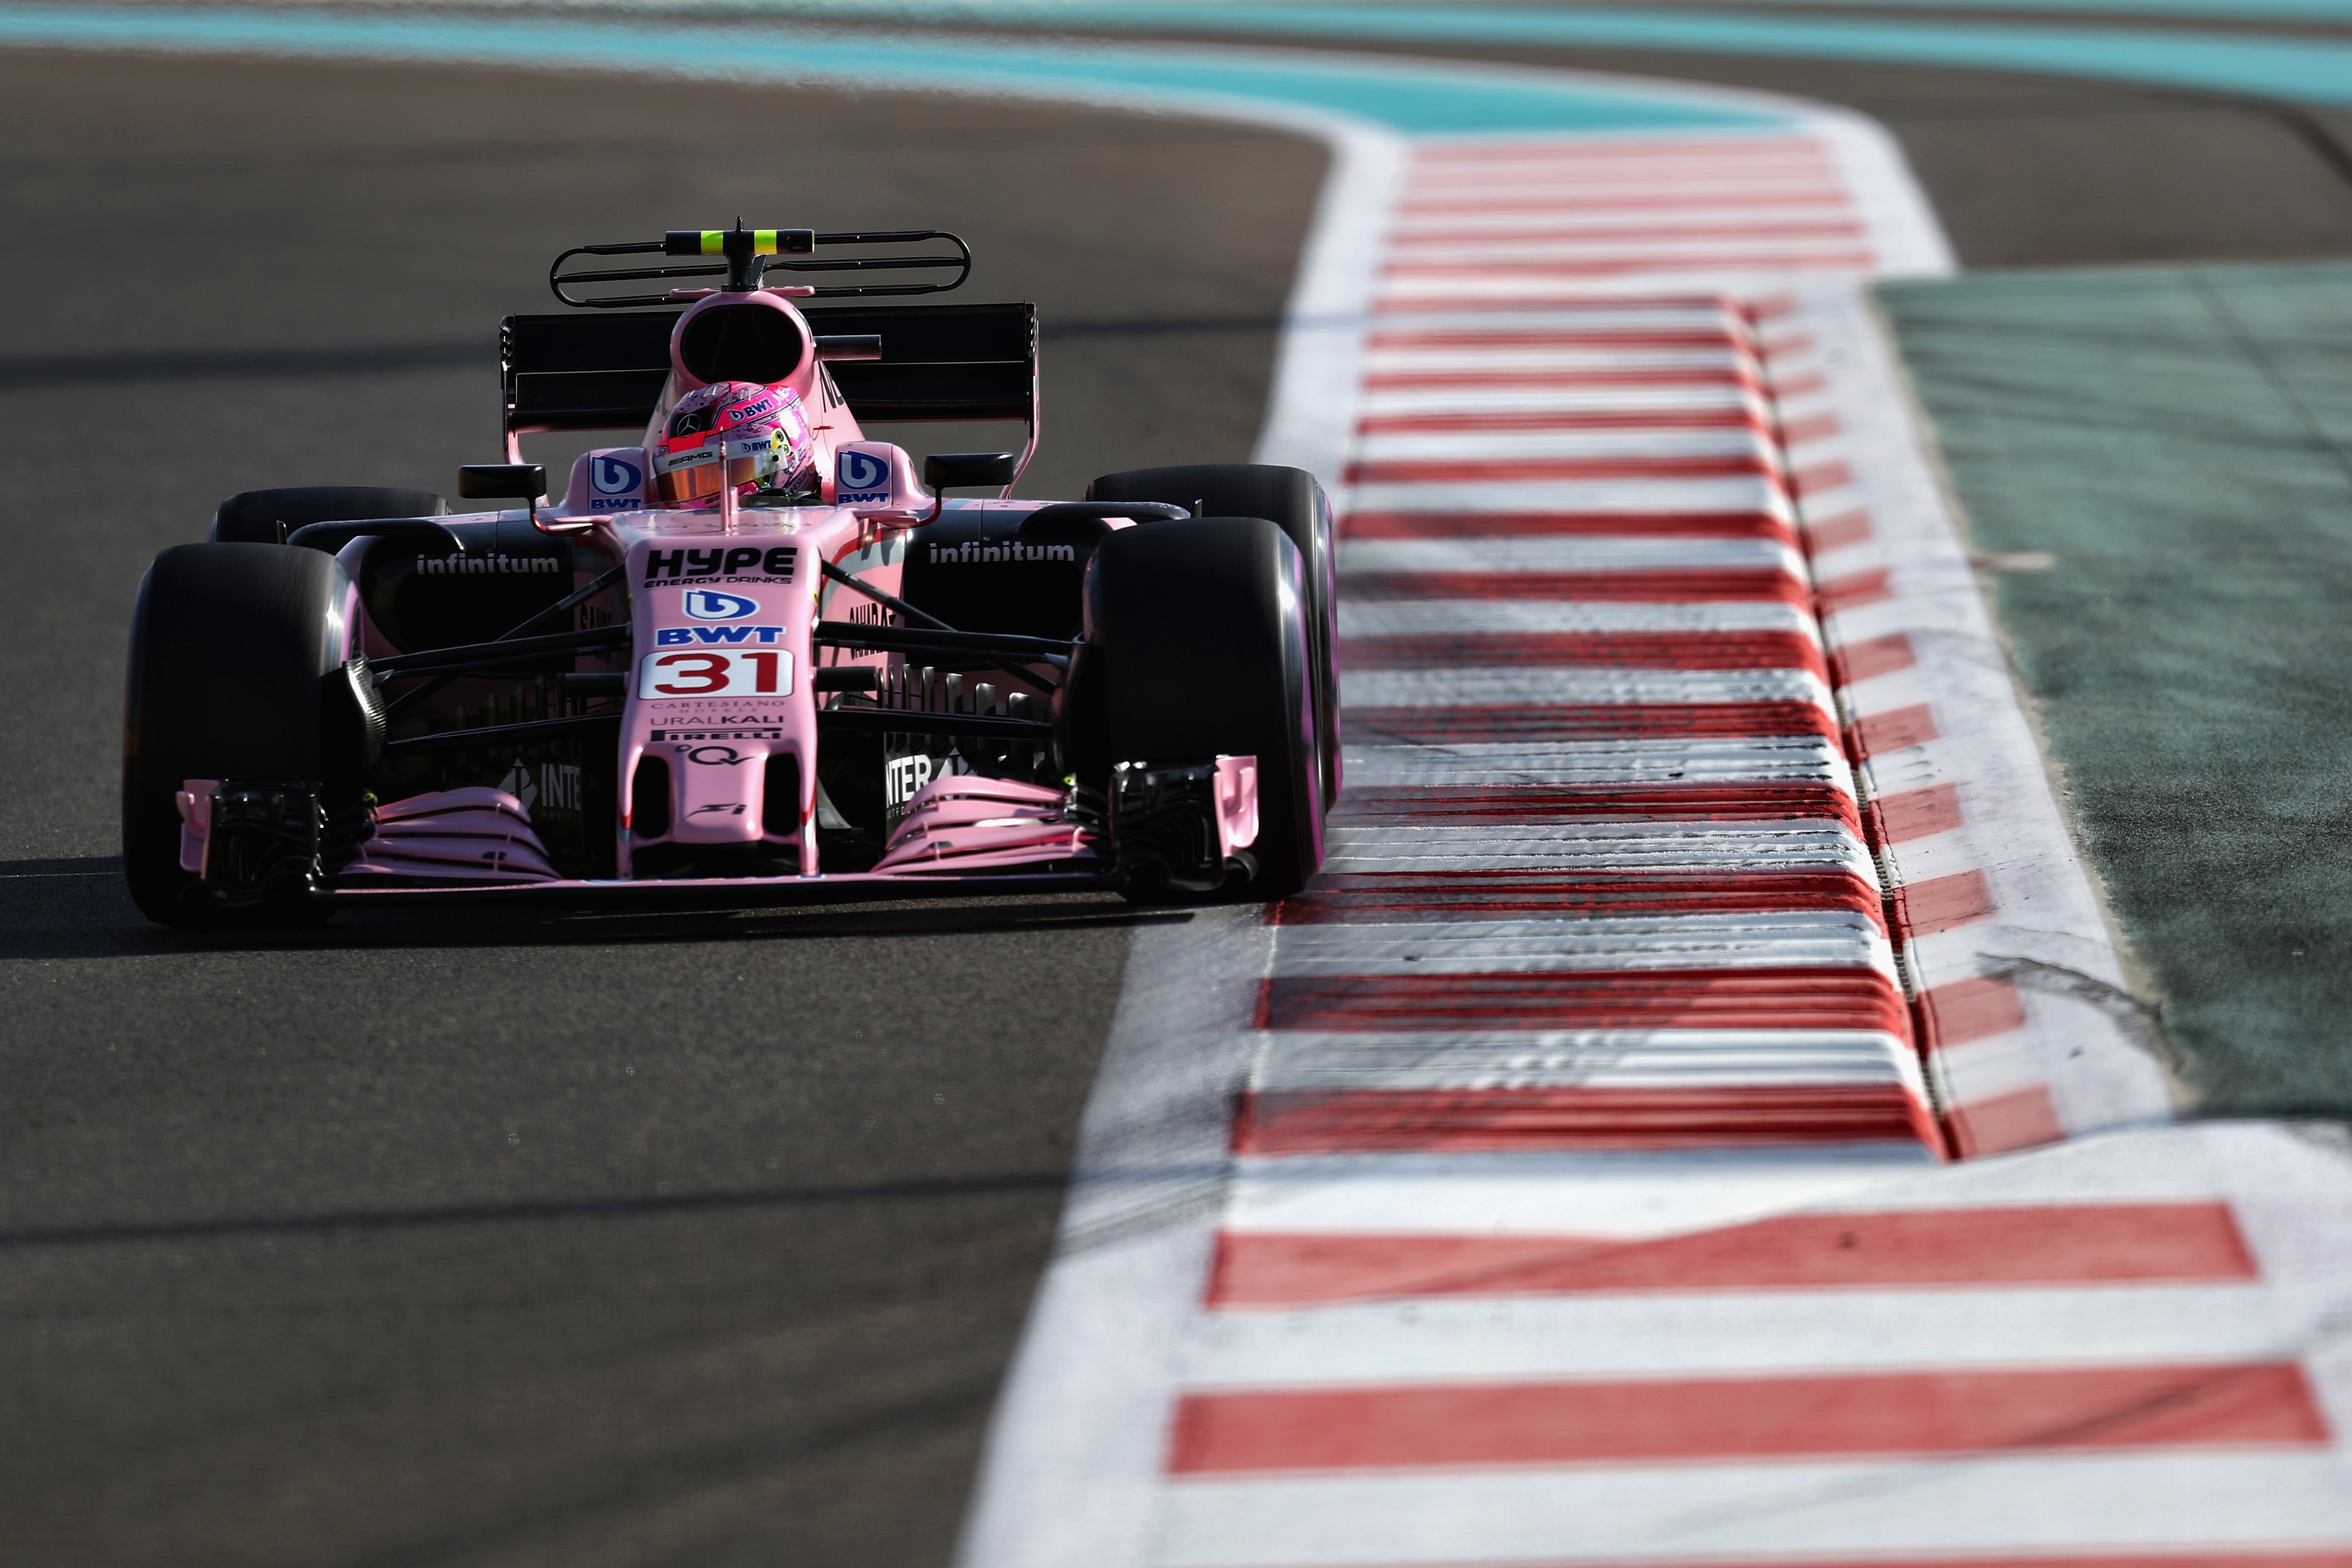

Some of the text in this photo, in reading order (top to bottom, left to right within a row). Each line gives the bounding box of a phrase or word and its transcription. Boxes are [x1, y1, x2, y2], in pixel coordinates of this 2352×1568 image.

[742, 399, 773, 418] BWT
[752, 440, 772, 451] BWT
[680, 451, 713, 462] AMG
[591, 498, 641, 509] BWT
[838, 492, 889, 504] BWT
[929, 540, 1075, 564] infinitum
[417, 552, 559, 575] infinitum
[646, 548, 797, 578] HYPE
[644, 577, 720, 588] ENERGY
[657, 626, 784, 646] BWT
[655, 653, 778, 694] 31
[651, 701, 785, 709] CARTESIANO
[651, 716, 784, 726] URALKALI
[651, 728, 782, 742] PIRELLI
